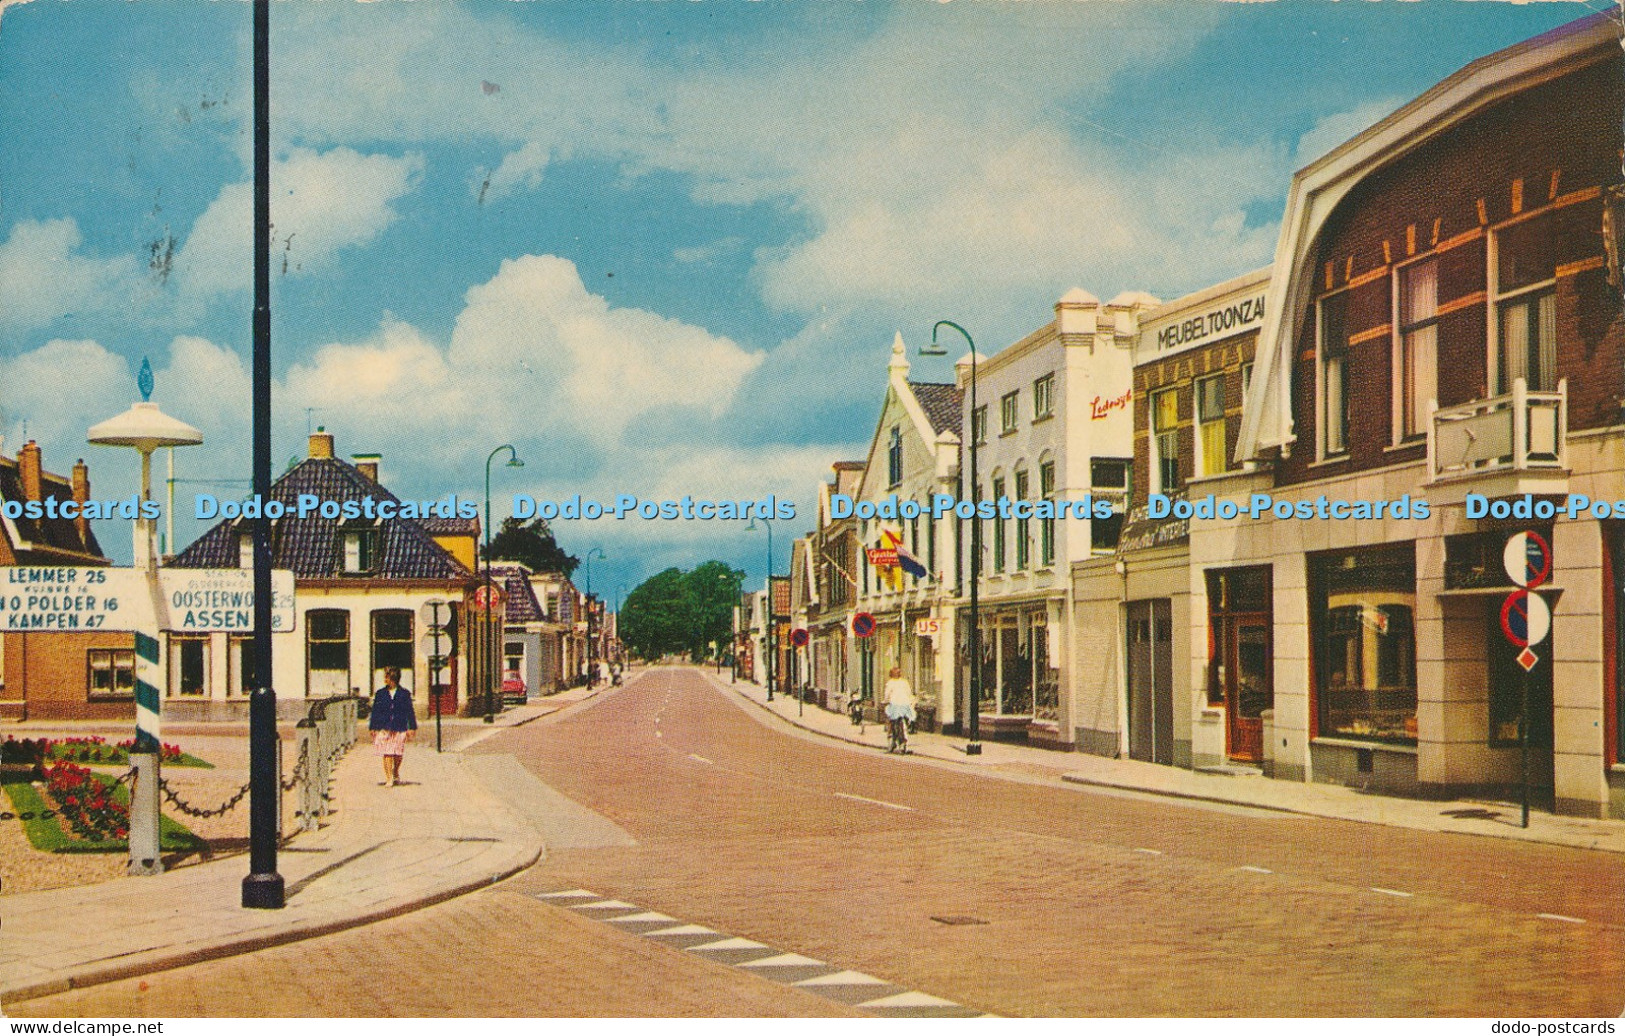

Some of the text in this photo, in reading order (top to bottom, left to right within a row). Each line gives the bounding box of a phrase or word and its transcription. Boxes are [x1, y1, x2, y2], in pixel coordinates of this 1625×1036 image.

[8, 568, 106, 583] LEMMER 25
[10, 595, 21, 611] O
[28, 595, 96, 611] POLDER
[104, 597, 118, 611] 16
[8, 613, 105, 628] KAMPEN 47
[183, 610, 250, 628] ASSEN
